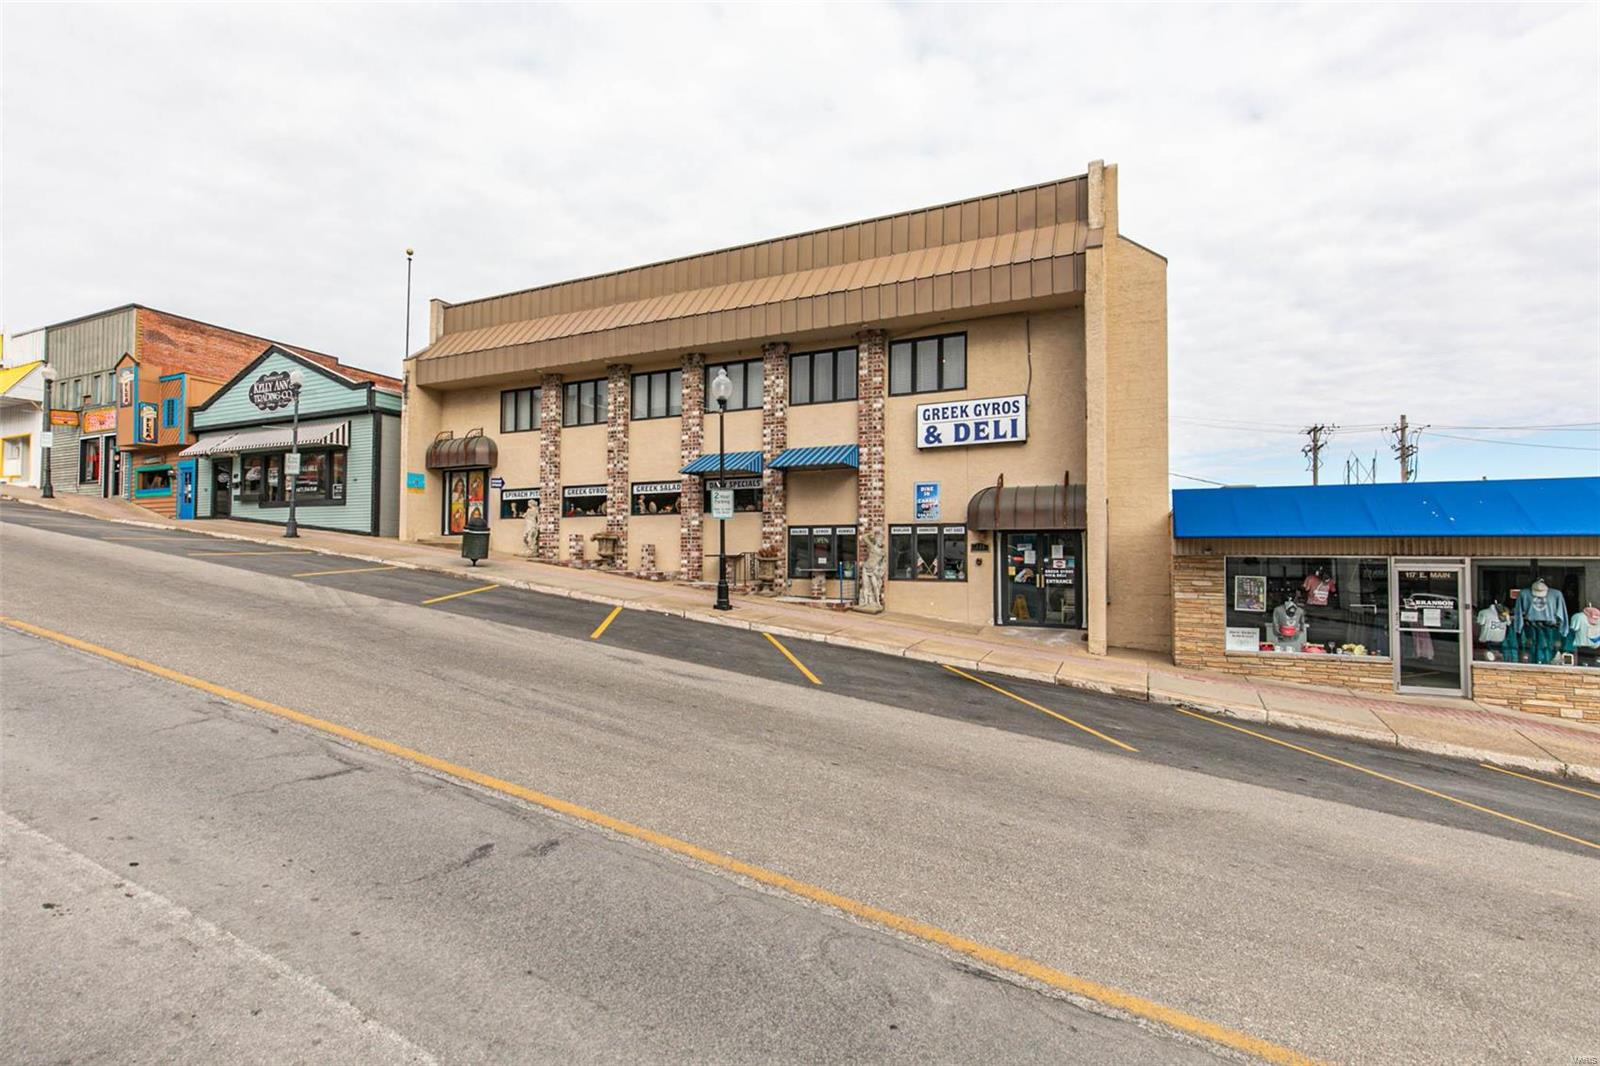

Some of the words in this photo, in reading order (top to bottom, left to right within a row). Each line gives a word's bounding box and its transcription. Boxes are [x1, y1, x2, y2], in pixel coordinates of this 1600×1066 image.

[923, 405, 969, 421] GREEK
[973, 400, 1020, 417] GYROS
[924, 425, 943, 444] &
[954, 418, 1018, 442] DELI
[636, 484, 658, 492] GREEK
[729, 480, 761, 489] SPECIALS
[505, 490, 528, 499] SPINACH
[567, 487, 586, 496] GREEK
[588, 486, 608, 495] GYROS
